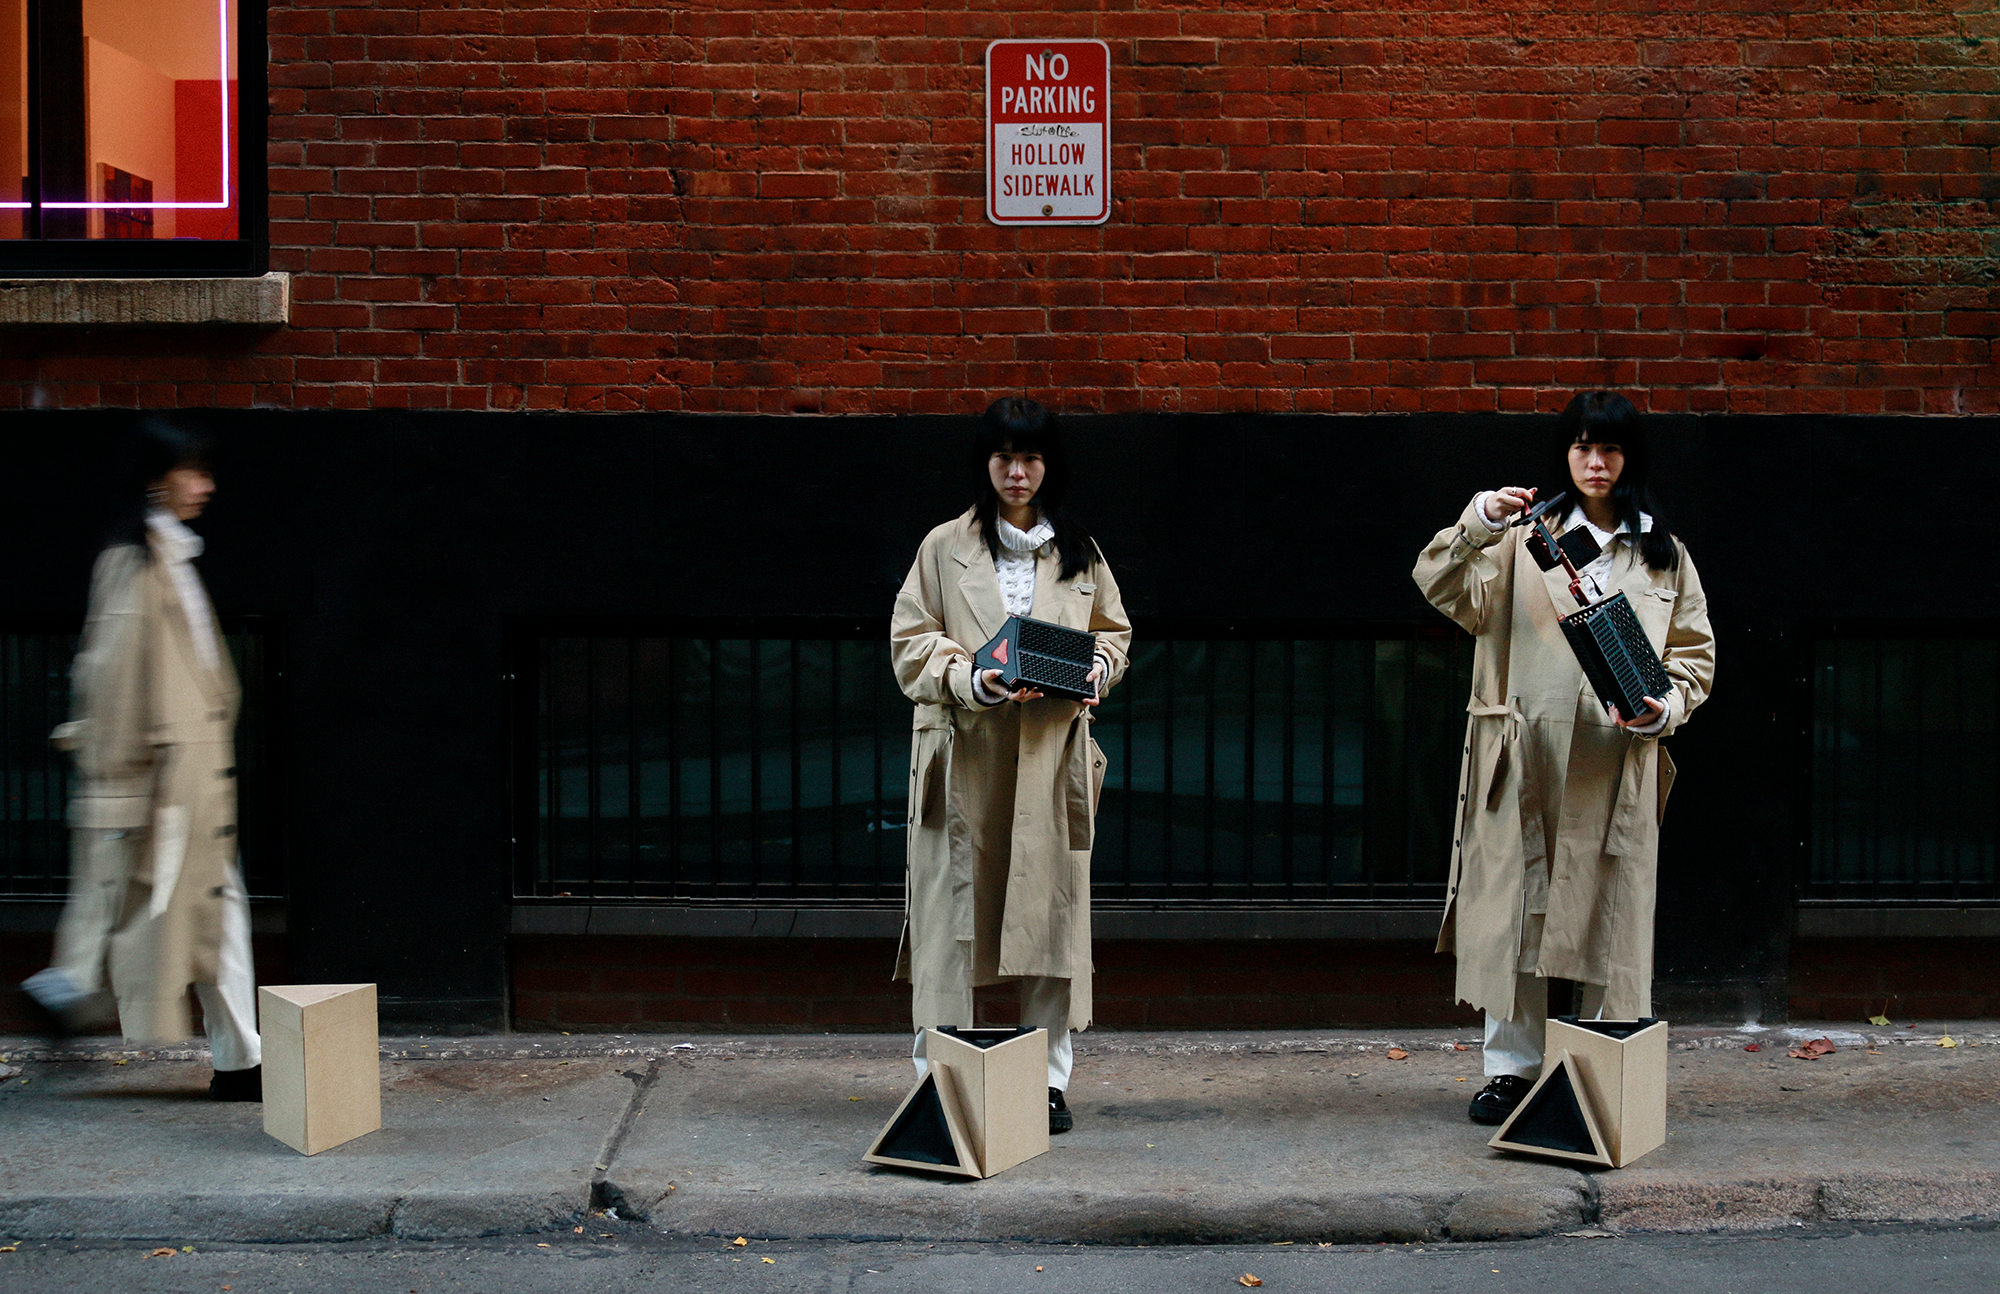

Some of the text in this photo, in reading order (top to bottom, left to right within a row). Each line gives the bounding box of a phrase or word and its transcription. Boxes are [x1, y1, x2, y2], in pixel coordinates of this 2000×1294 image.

[1026, 53, 1069, 81] NO
[1001, 86, 1095, 114] PARKING
[1012, 143, 1085, 165] HOLLOW
[1003, 174, 1095, 196] SIDEWALK
